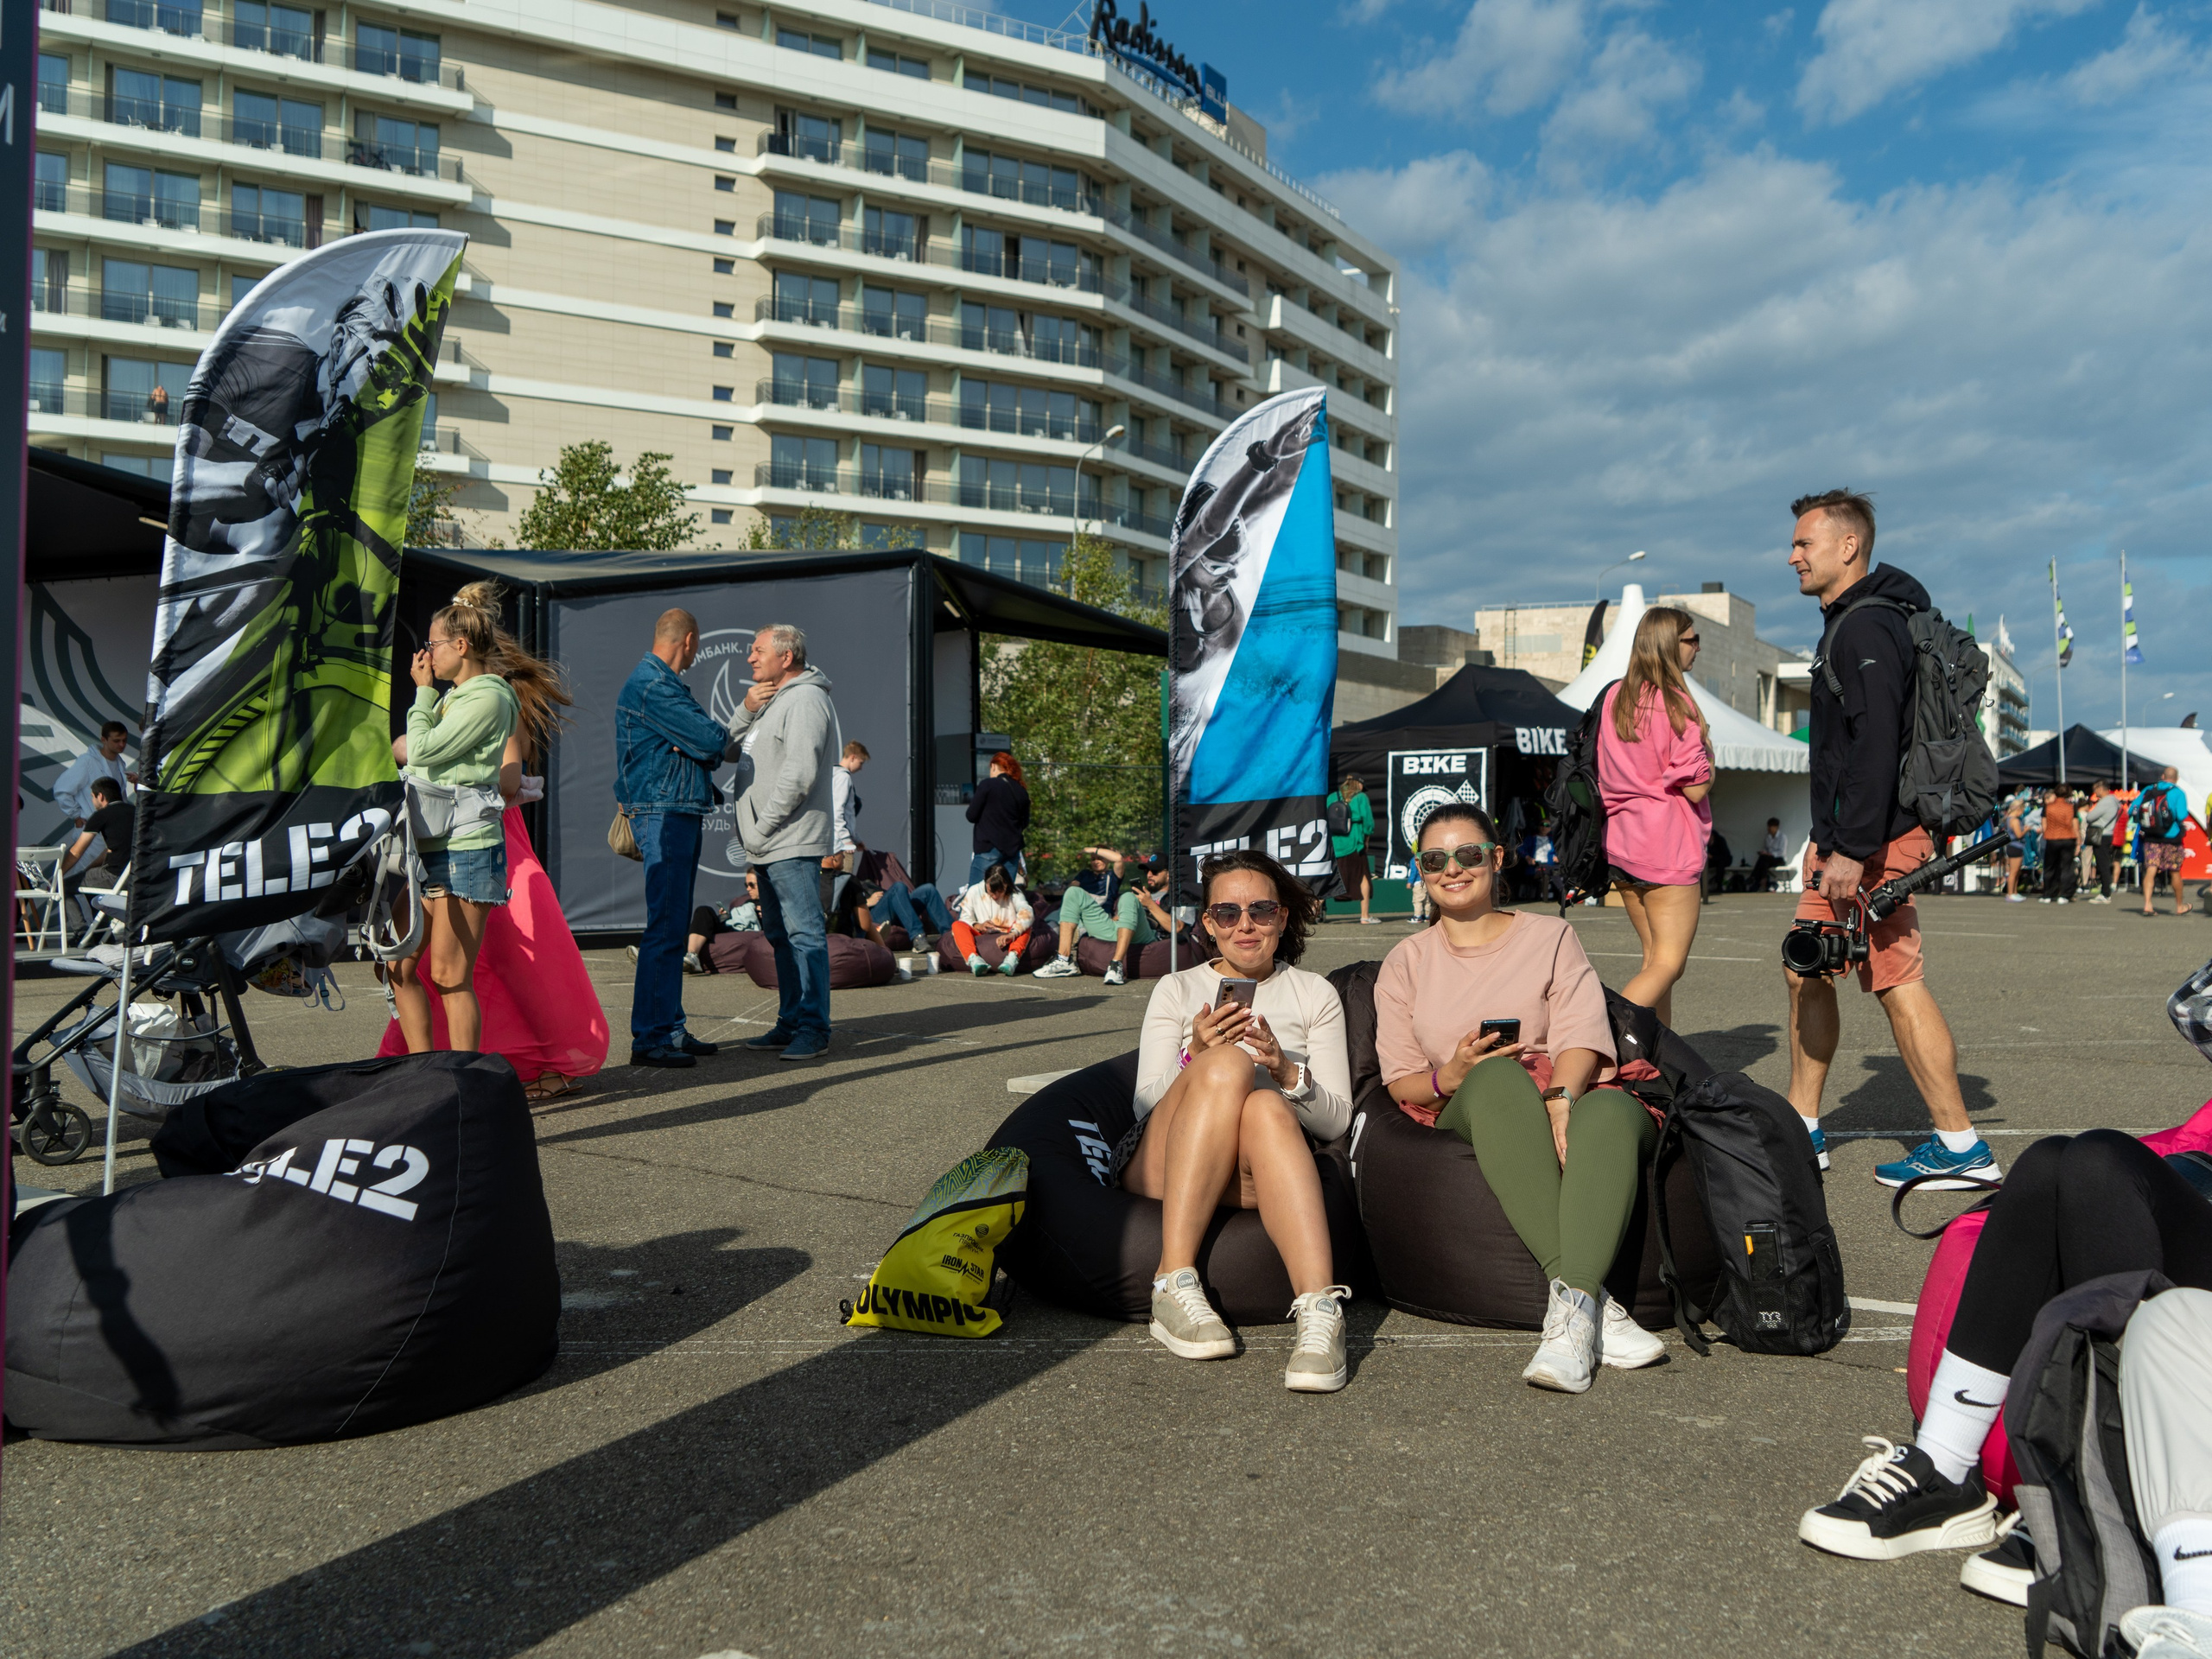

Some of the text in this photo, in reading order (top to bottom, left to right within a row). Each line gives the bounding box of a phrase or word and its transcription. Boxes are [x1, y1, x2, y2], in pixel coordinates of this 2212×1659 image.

[1515, 728, 1569, 754] BIKE
[1402, 755, 1467, 774] BIKE
[168, 808, 391, 906] TELE2
[1190, 819, 1332, 884] TE2
[222, 1138, 430, 1222] LE2
[942, 1255, 984, 1279] IRON STAR
